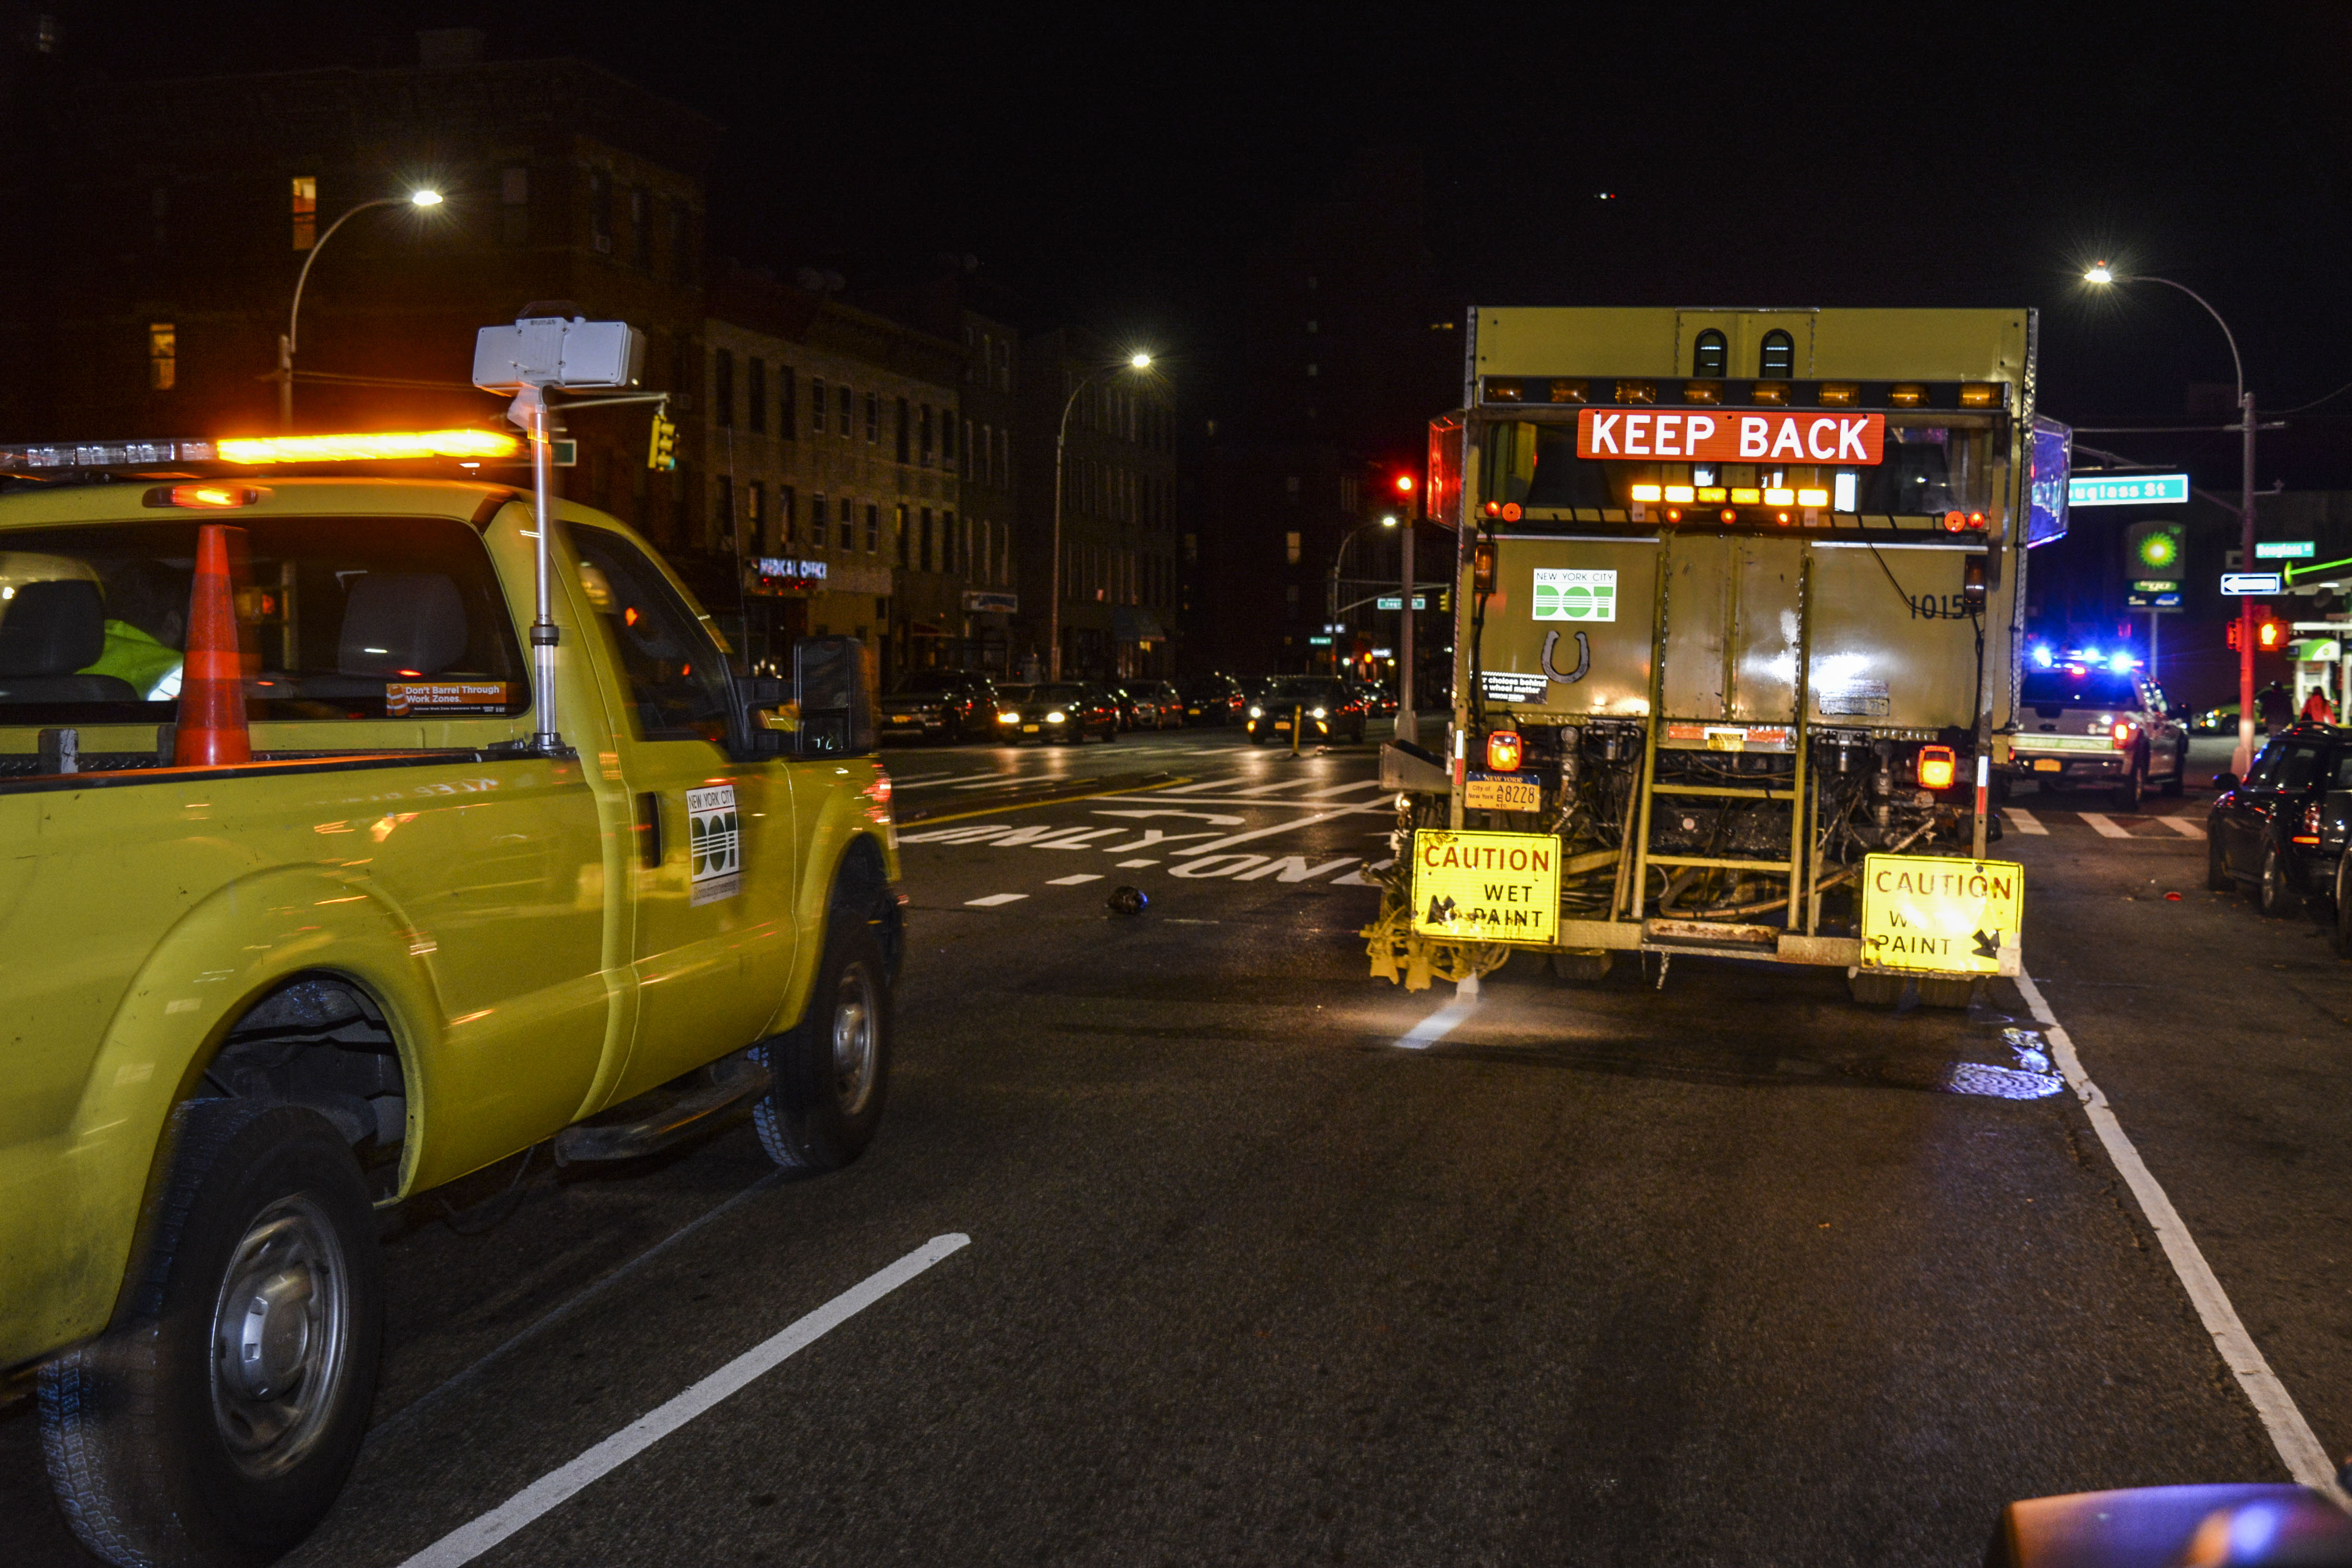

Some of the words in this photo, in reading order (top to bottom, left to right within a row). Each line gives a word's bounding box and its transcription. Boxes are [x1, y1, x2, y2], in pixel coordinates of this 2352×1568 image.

[1591, 414, 1715, 456] KEEP
[1740, 417, 1868, 460] BACK
[2068, 485, 2139, 501] uglass
[2145, 483, 2165, 496] St
[760, 558, 798, 577] MEDICAL
[1536, 585, 1613, 618] DOT
[1910, 594, 1965, 619] 1015
[406, 686, 430, 695] Don't
[433, 685, 459, 694] Barrel
[462, 685, 499, 695] Through
[1488, 677, 1518, 685] choices
[1520, 679, 1547, 687] behind
[689, 795, 702, 809] NEW
[704, 792, 720, 806] YORK
[721, 790, 733, 804] CITY
[691, 812, 737, 876] DOT
[897, 825, 1228, 852] ONLY
[1425, 846, 1549, 872] CAUTION
[1168, 854, 1398, 887] ONL
[1484, 884, 1533, 902] WET
[1877, 870, 2011, 900] CAUTION
[1474, 908, 1543, 927] PAINT
[1877, 935, 1952, 955] PAINT
